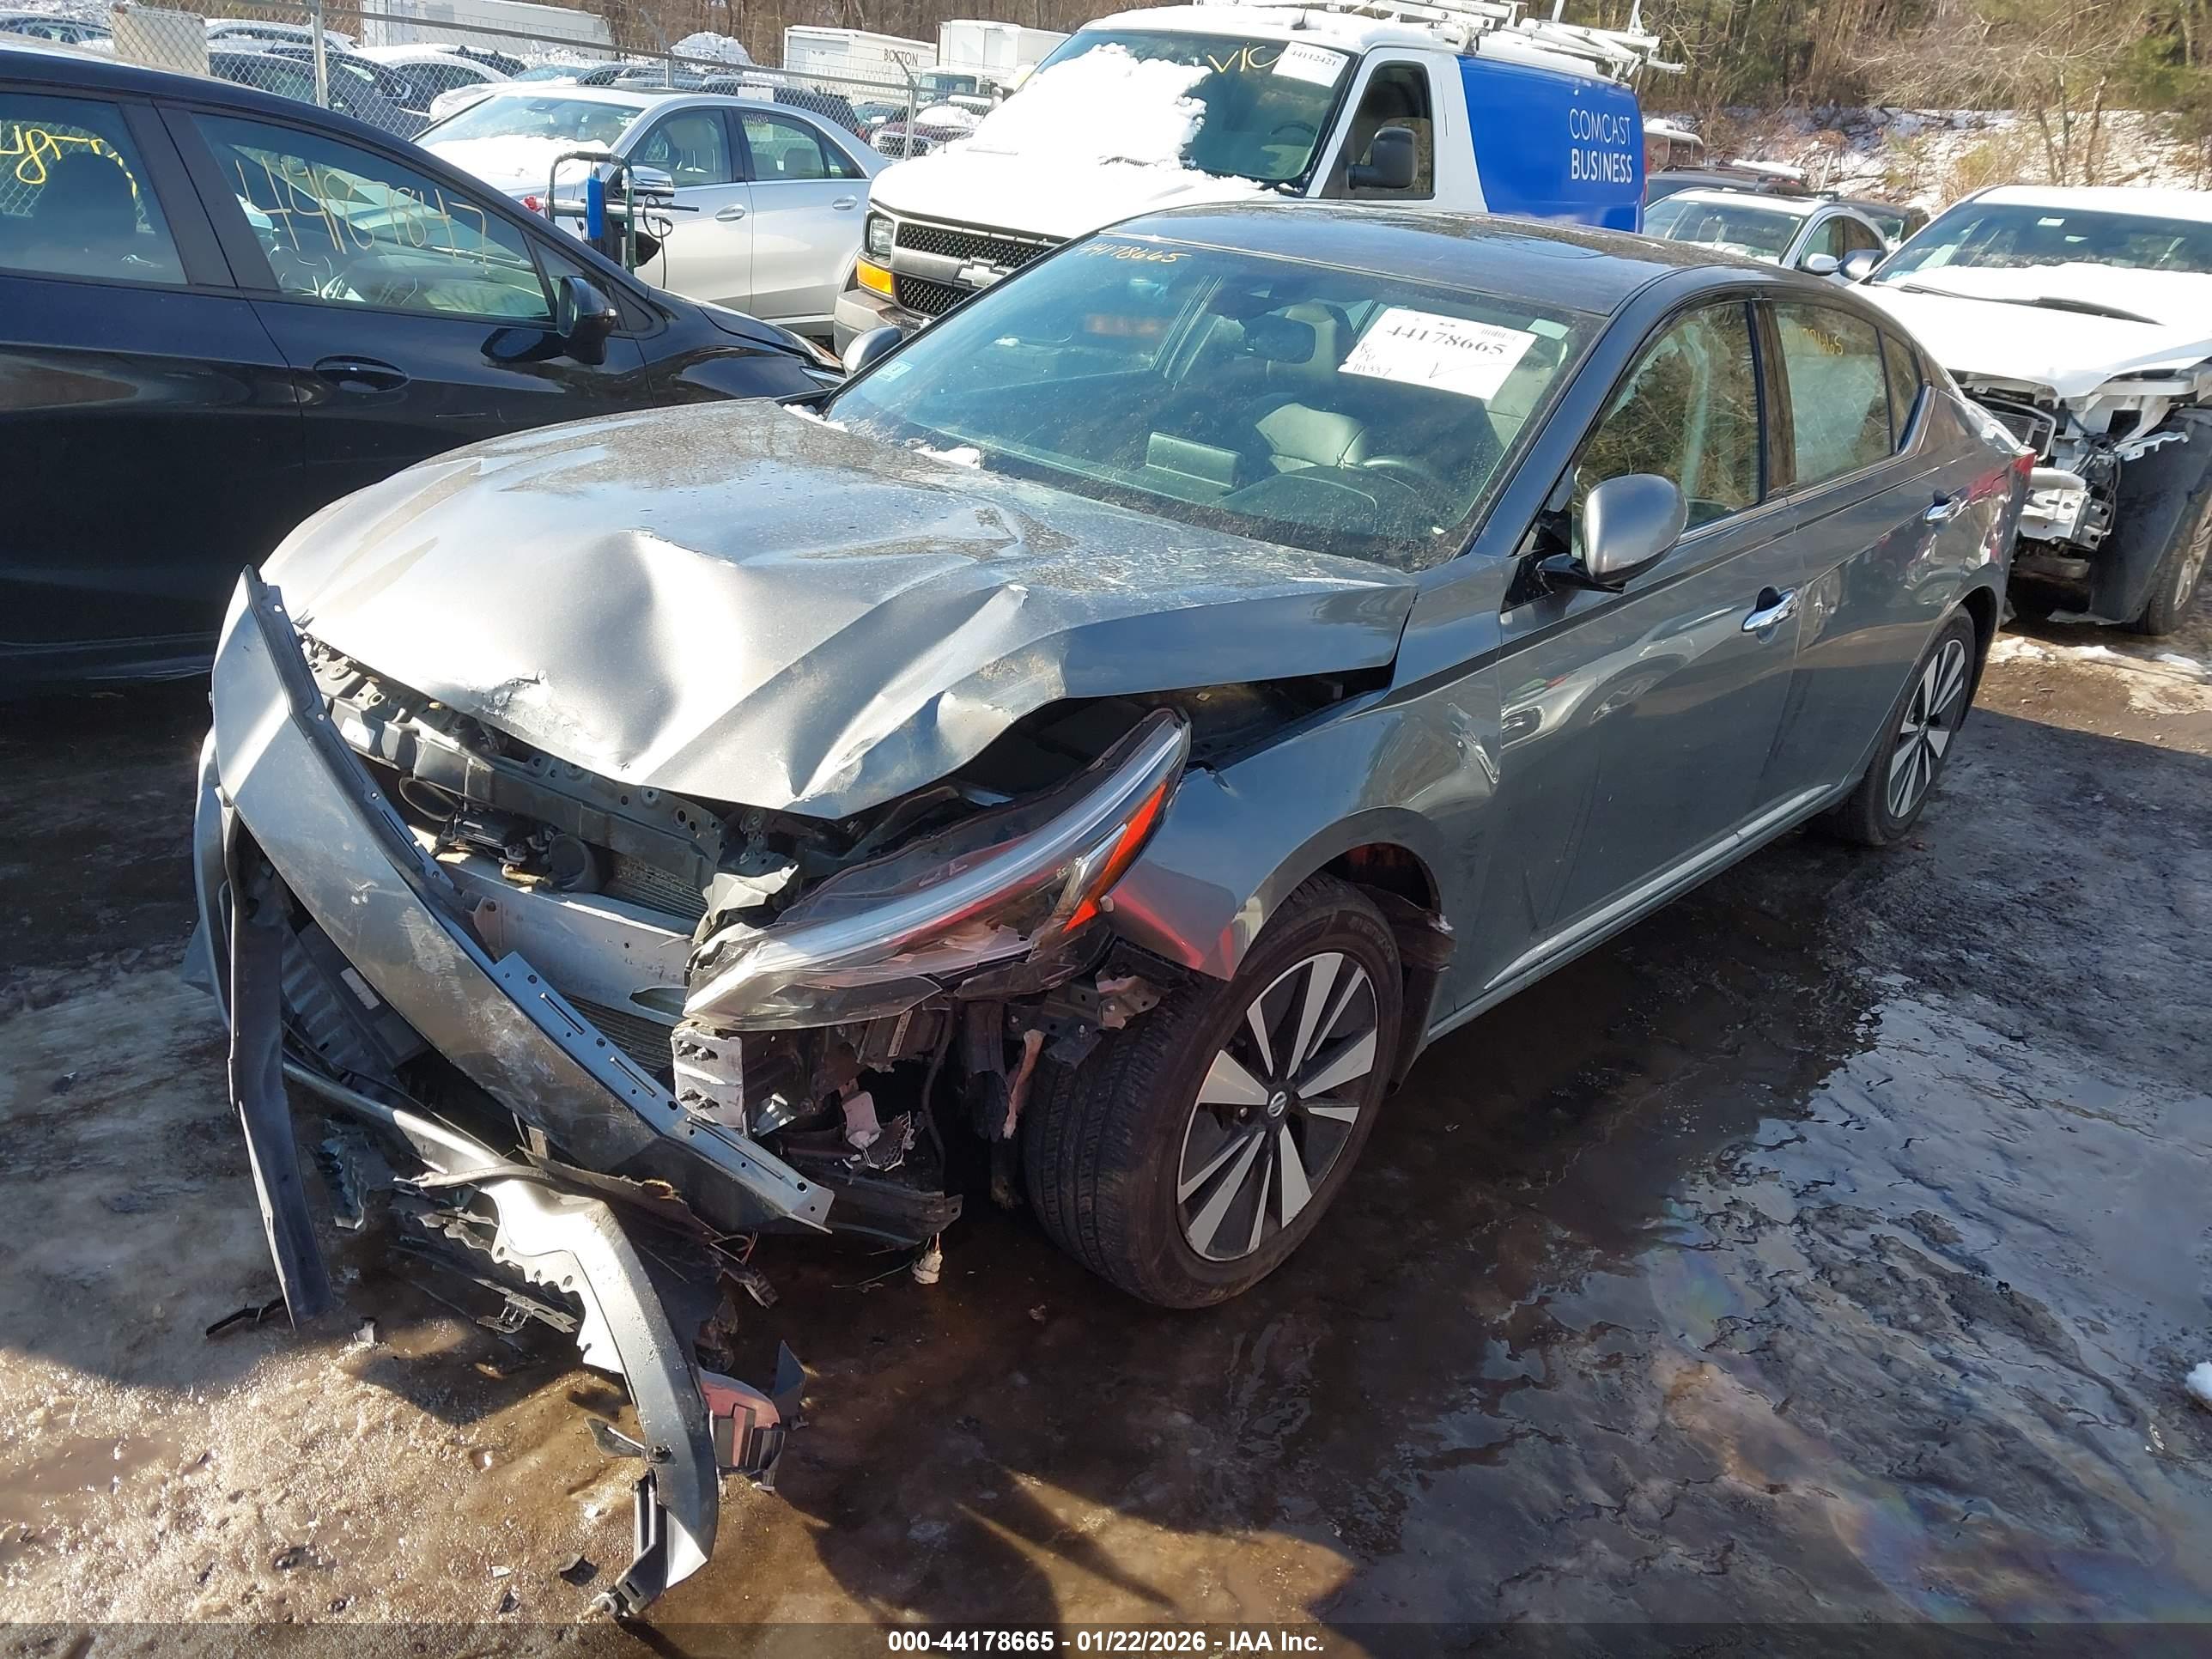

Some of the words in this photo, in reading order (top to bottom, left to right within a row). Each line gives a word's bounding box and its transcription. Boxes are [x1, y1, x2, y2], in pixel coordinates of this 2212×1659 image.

[884, 47, 919, 67] BOSTON
[1569, 108, 1631, 146] COMCAST
[1571, 148, 1633, 184] BUSINESS
[1073, 242, 1193, 263] 44178665
[1387, 325, 1508, 355] 44178665
